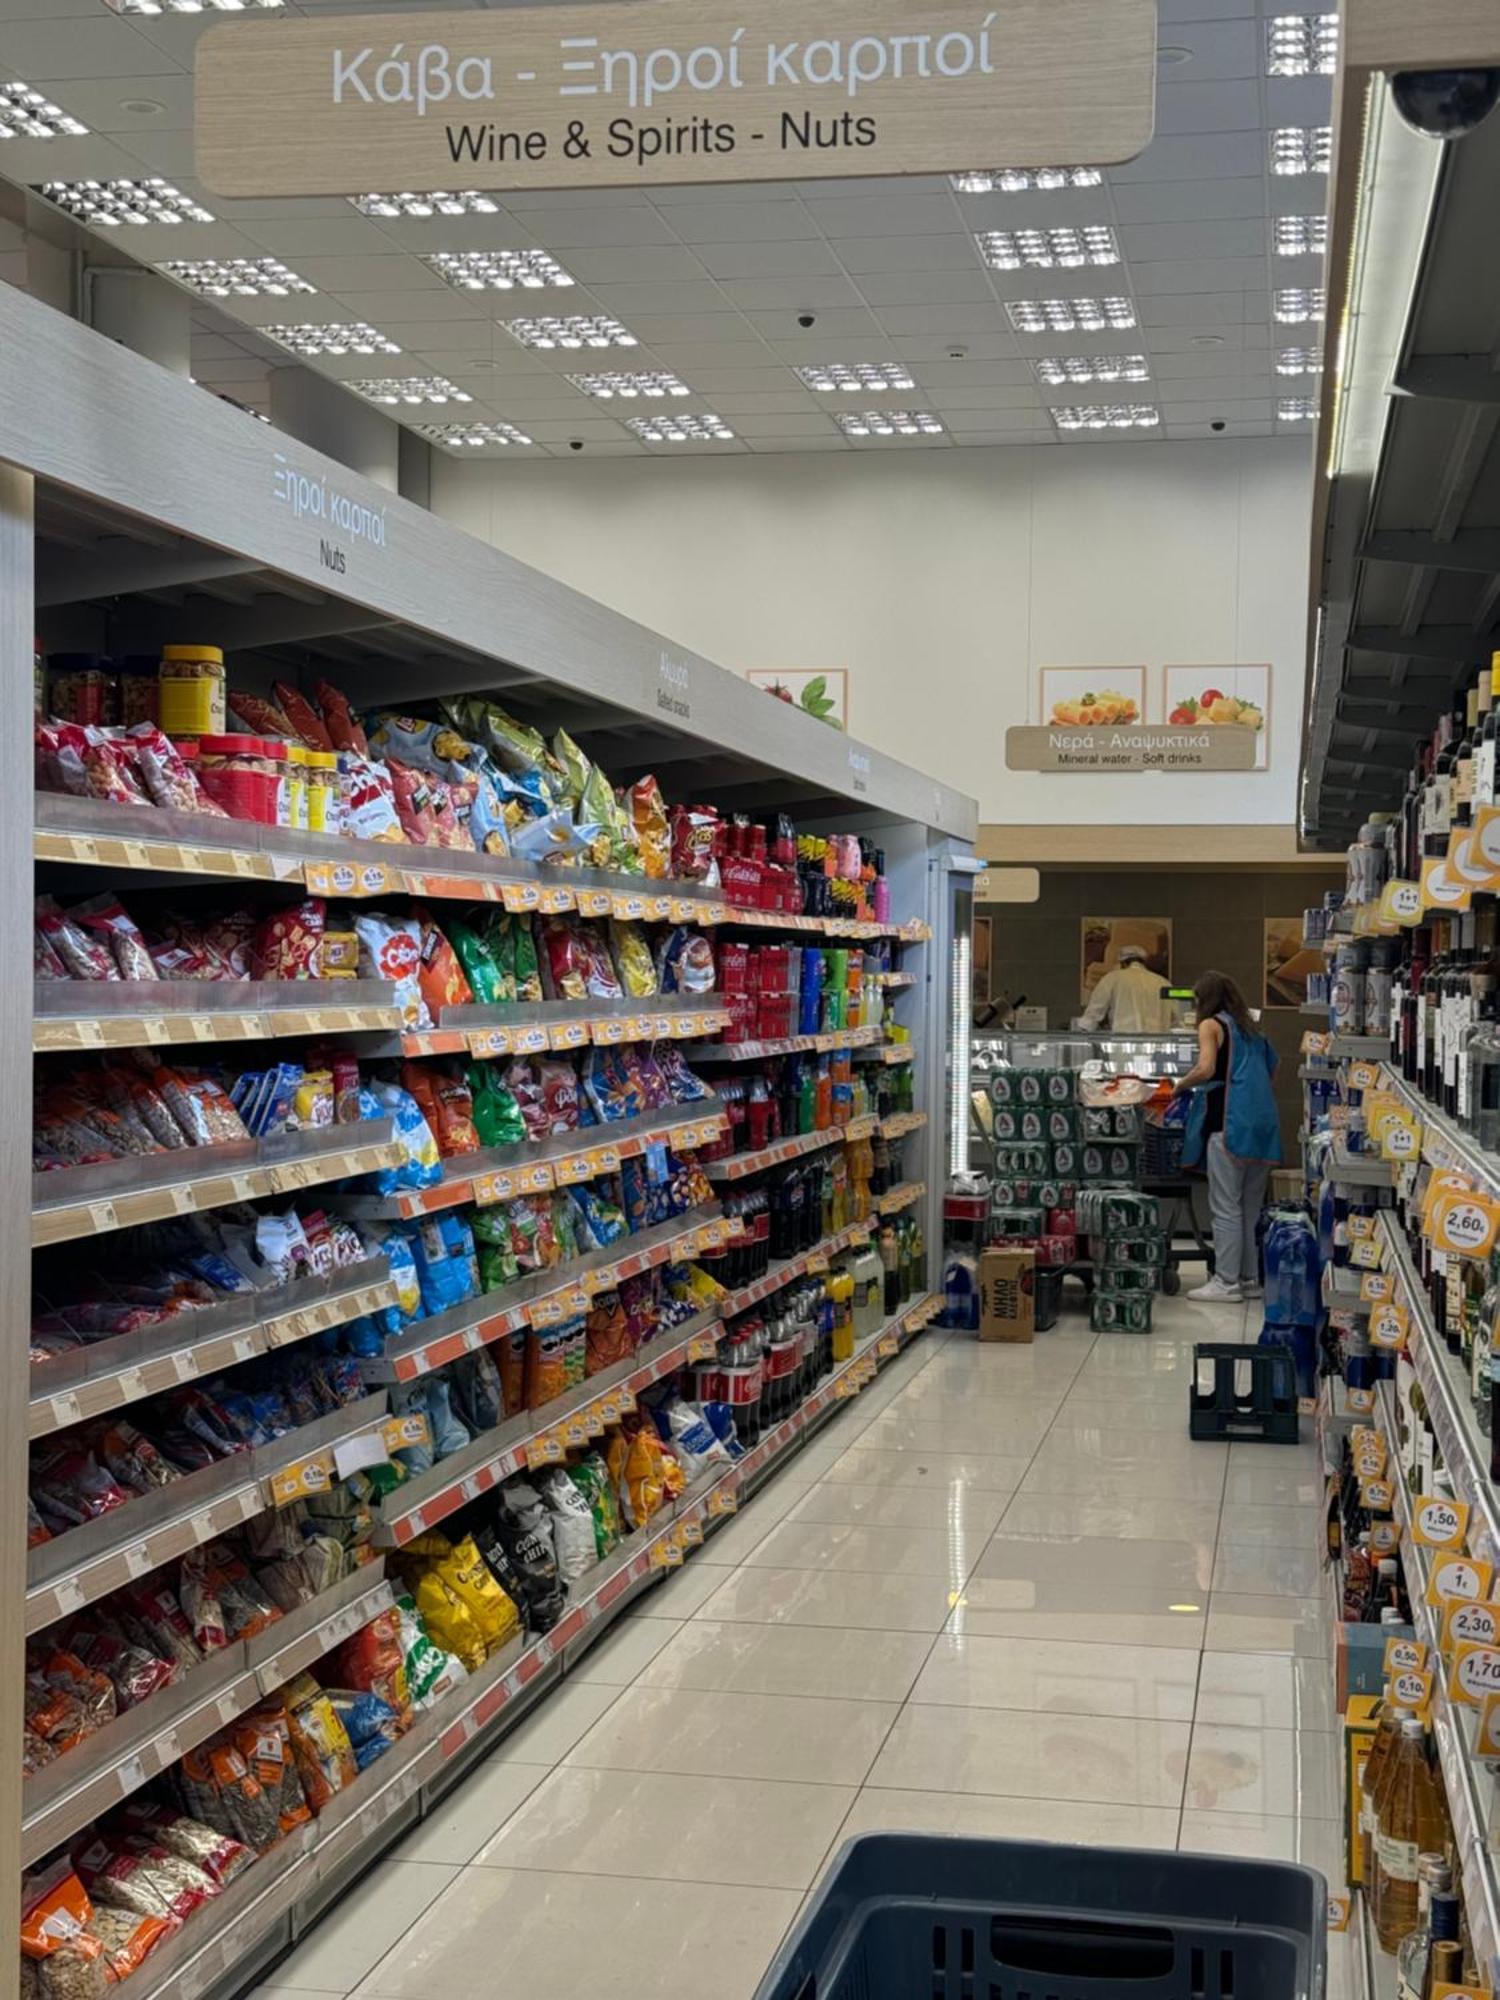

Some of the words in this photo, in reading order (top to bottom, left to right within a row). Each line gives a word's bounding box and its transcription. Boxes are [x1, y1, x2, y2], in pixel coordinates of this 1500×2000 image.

[333, 43, 495, 115] Κάβα
[517, 72, 536, 80] -
[559, 27, 746, 108] Ξηροί
[767, 12, 997, 97] καρποί
[446, 125, 547, 162] Wine
[563, 120, 592, 160] &
[607, 115, 736, 166] Spirits
[780, 111, 877, 149] Nuts
[273, 453, 326, 518] Ξηροί
[330, 491, 387, 547] καρποί
[319, 538, 346, 575] Nuts
[1049, 732, 1094, 752] Νερά
[1110, 732, 1211, 751] Αναψυκτικά
[1058, 753, 1099, 765] Mineral
[1101, 754, 1132, 765] water
[1142, 753, 1165, 765] Soft
[1168, 753, 1202, 764] drinks
[1447, 1211, 1485, 1234] 2,60€
[1457, 1614, 1495, 1634] 2,30€
